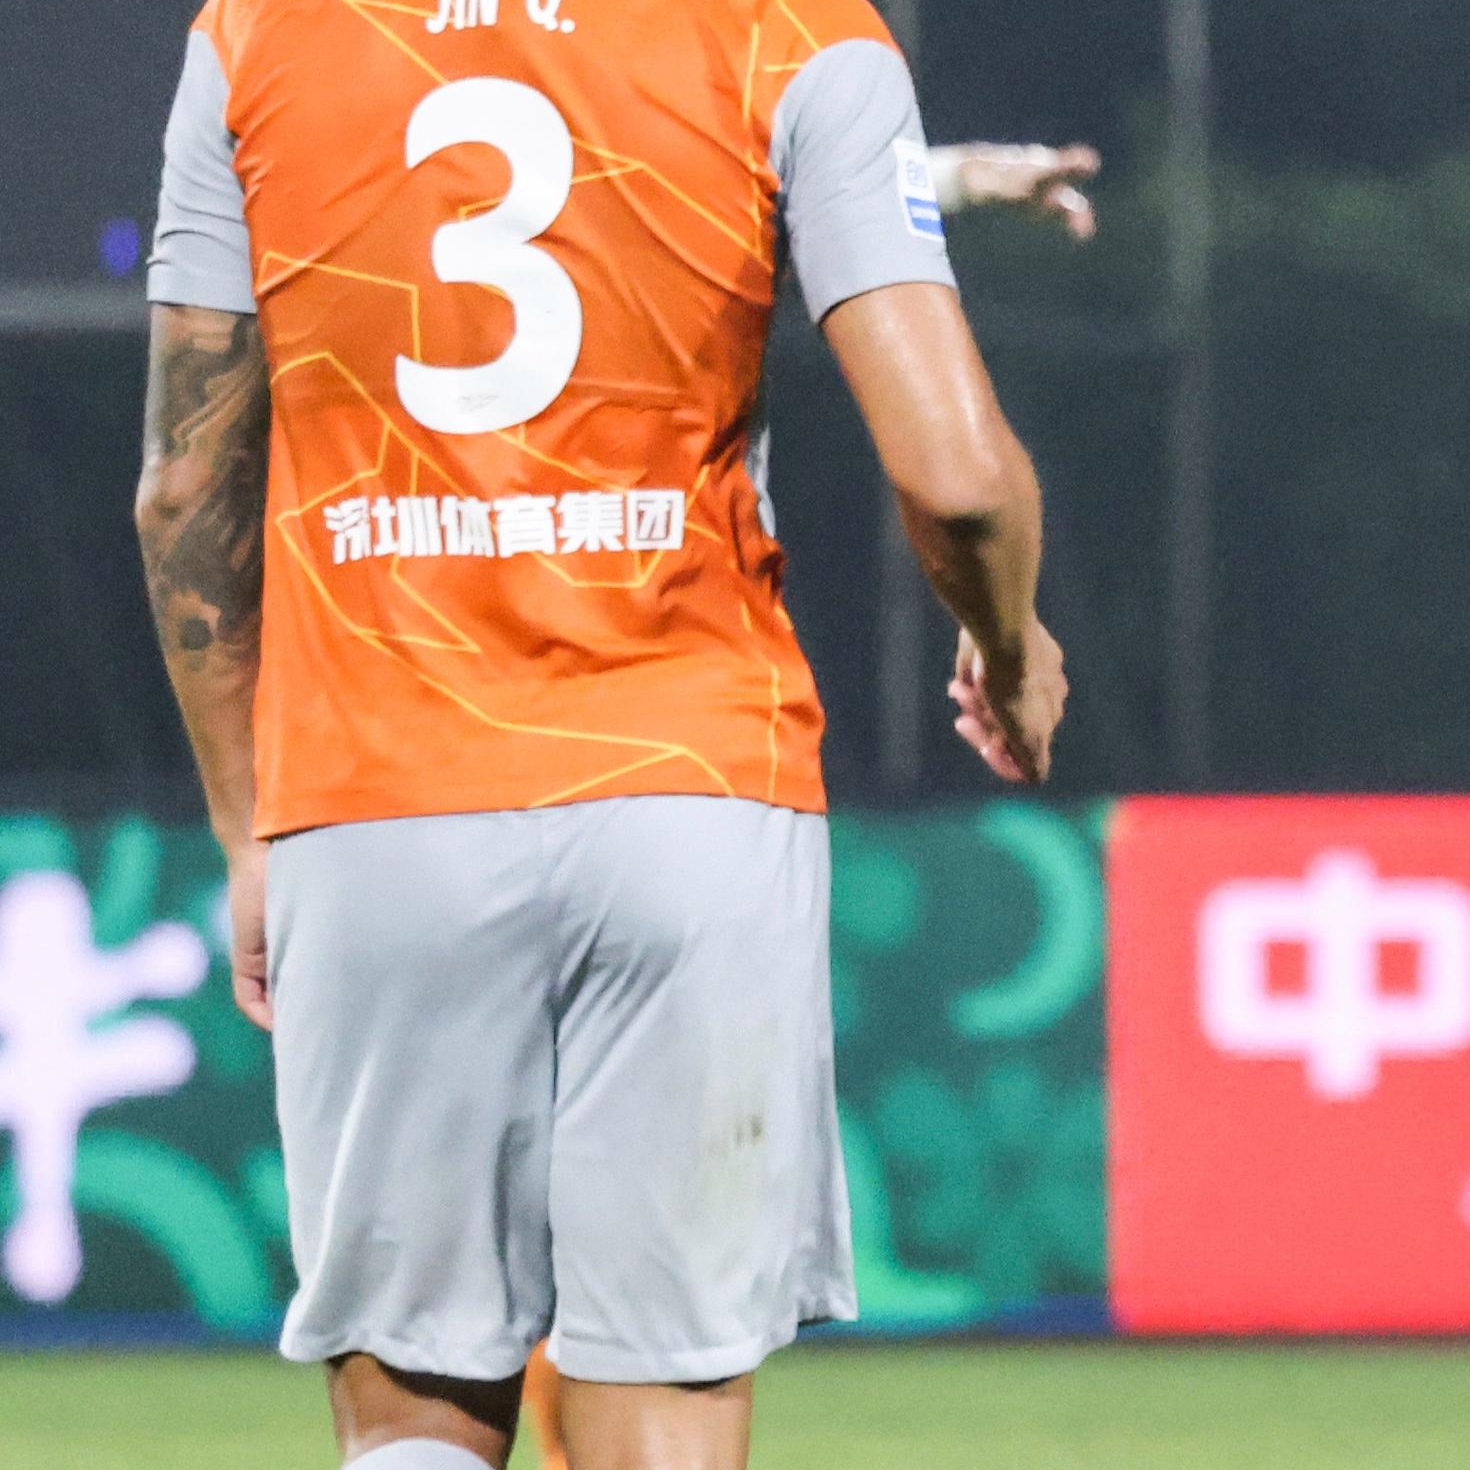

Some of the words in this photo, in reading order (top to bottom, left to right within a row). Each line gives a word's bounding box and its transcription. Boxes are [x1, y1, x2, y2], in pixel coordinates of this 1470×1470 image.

[395, 76, 583, 434] 3
[323, 488, 686, 564] 深圳体育集团
